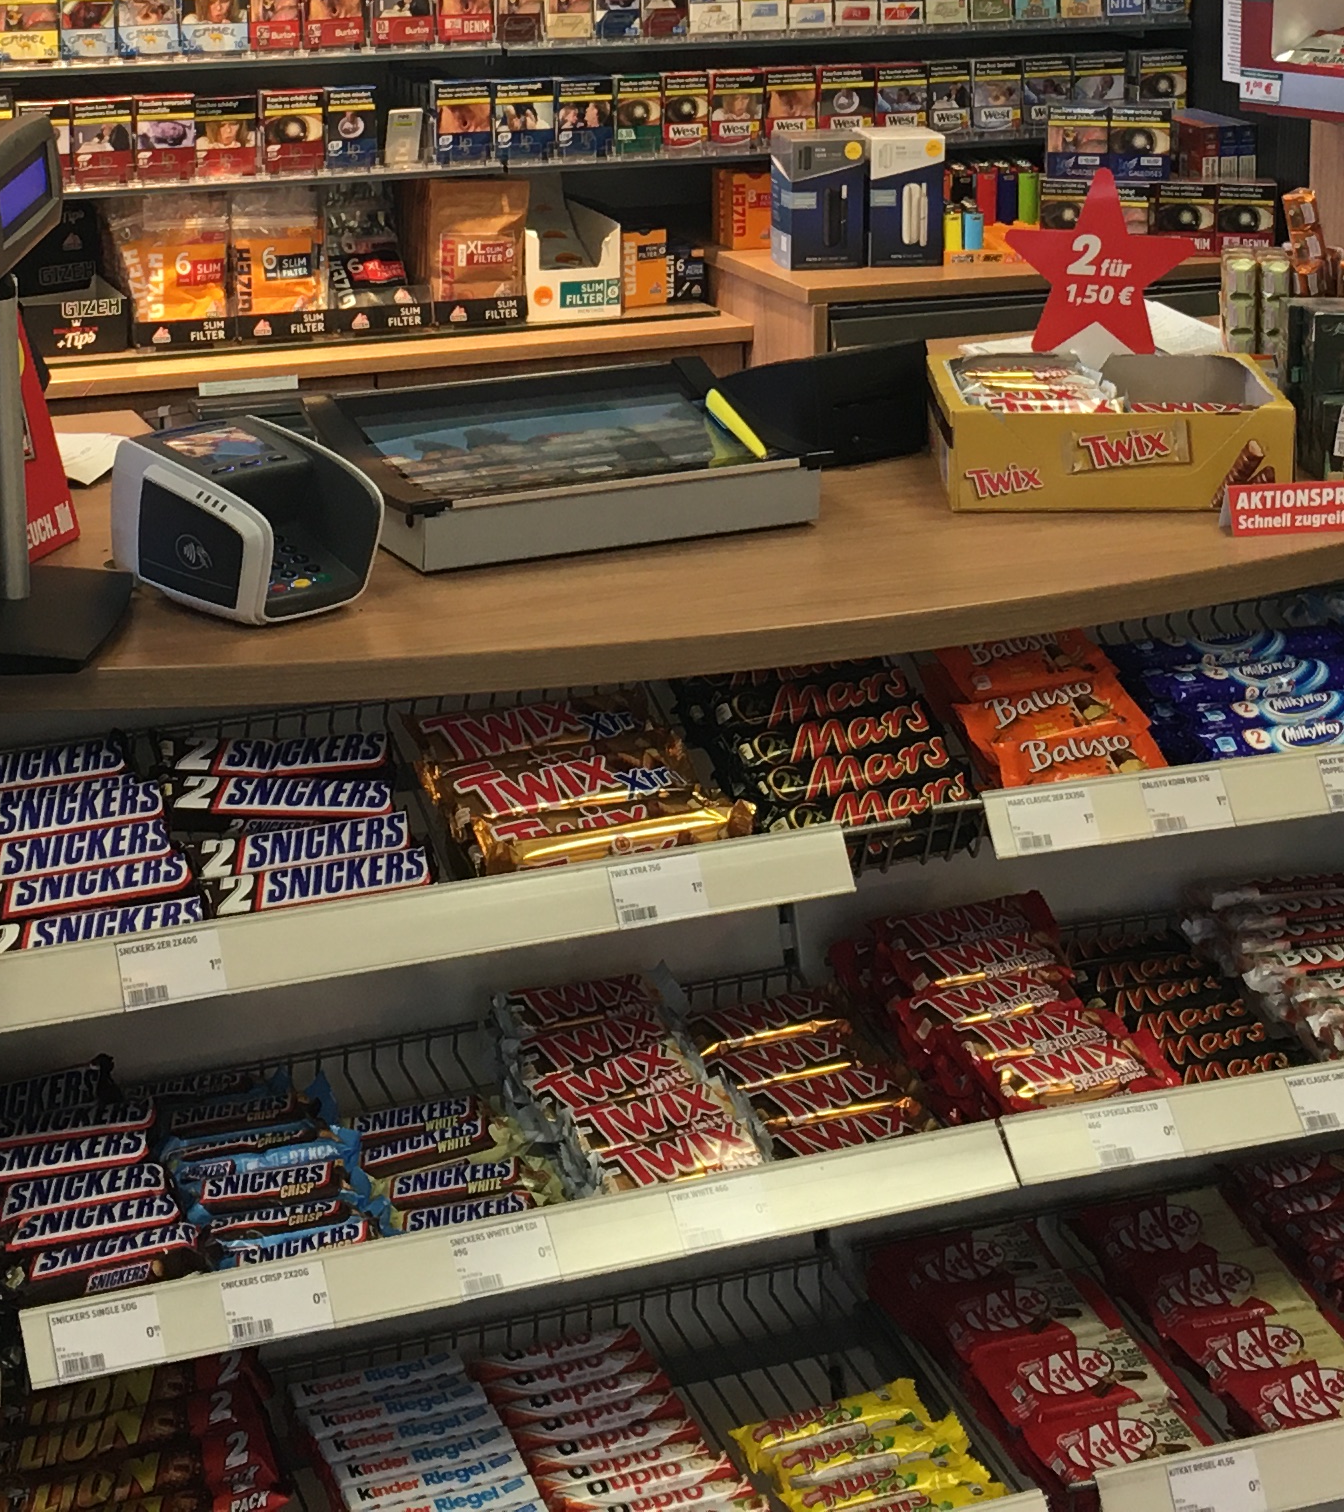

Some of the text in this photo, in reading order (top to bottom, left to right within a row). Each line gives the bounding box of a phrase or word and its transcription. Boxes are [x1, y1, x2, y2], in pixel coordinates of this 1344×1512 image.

[1066, 233, 1132, 279] 2 für
[1065, 283, 1115, 305] 1,50
[62, 298, 122, 317] GIZEH
[190, 330, 225, 342] FILTER
[203, 321, 224, 330] SLIM
[1237, 511, 1291, 530] Schnell
[792, 699, 930, 762] Mars
[1019, 731, 1130, 773] Balisto
[267, 847, 426, 902] SNICKERS
[51, 1302, 137, 1326] SNICKERS SINGLE 50G
[1035, 1349, 1114, 1398] KitKat
